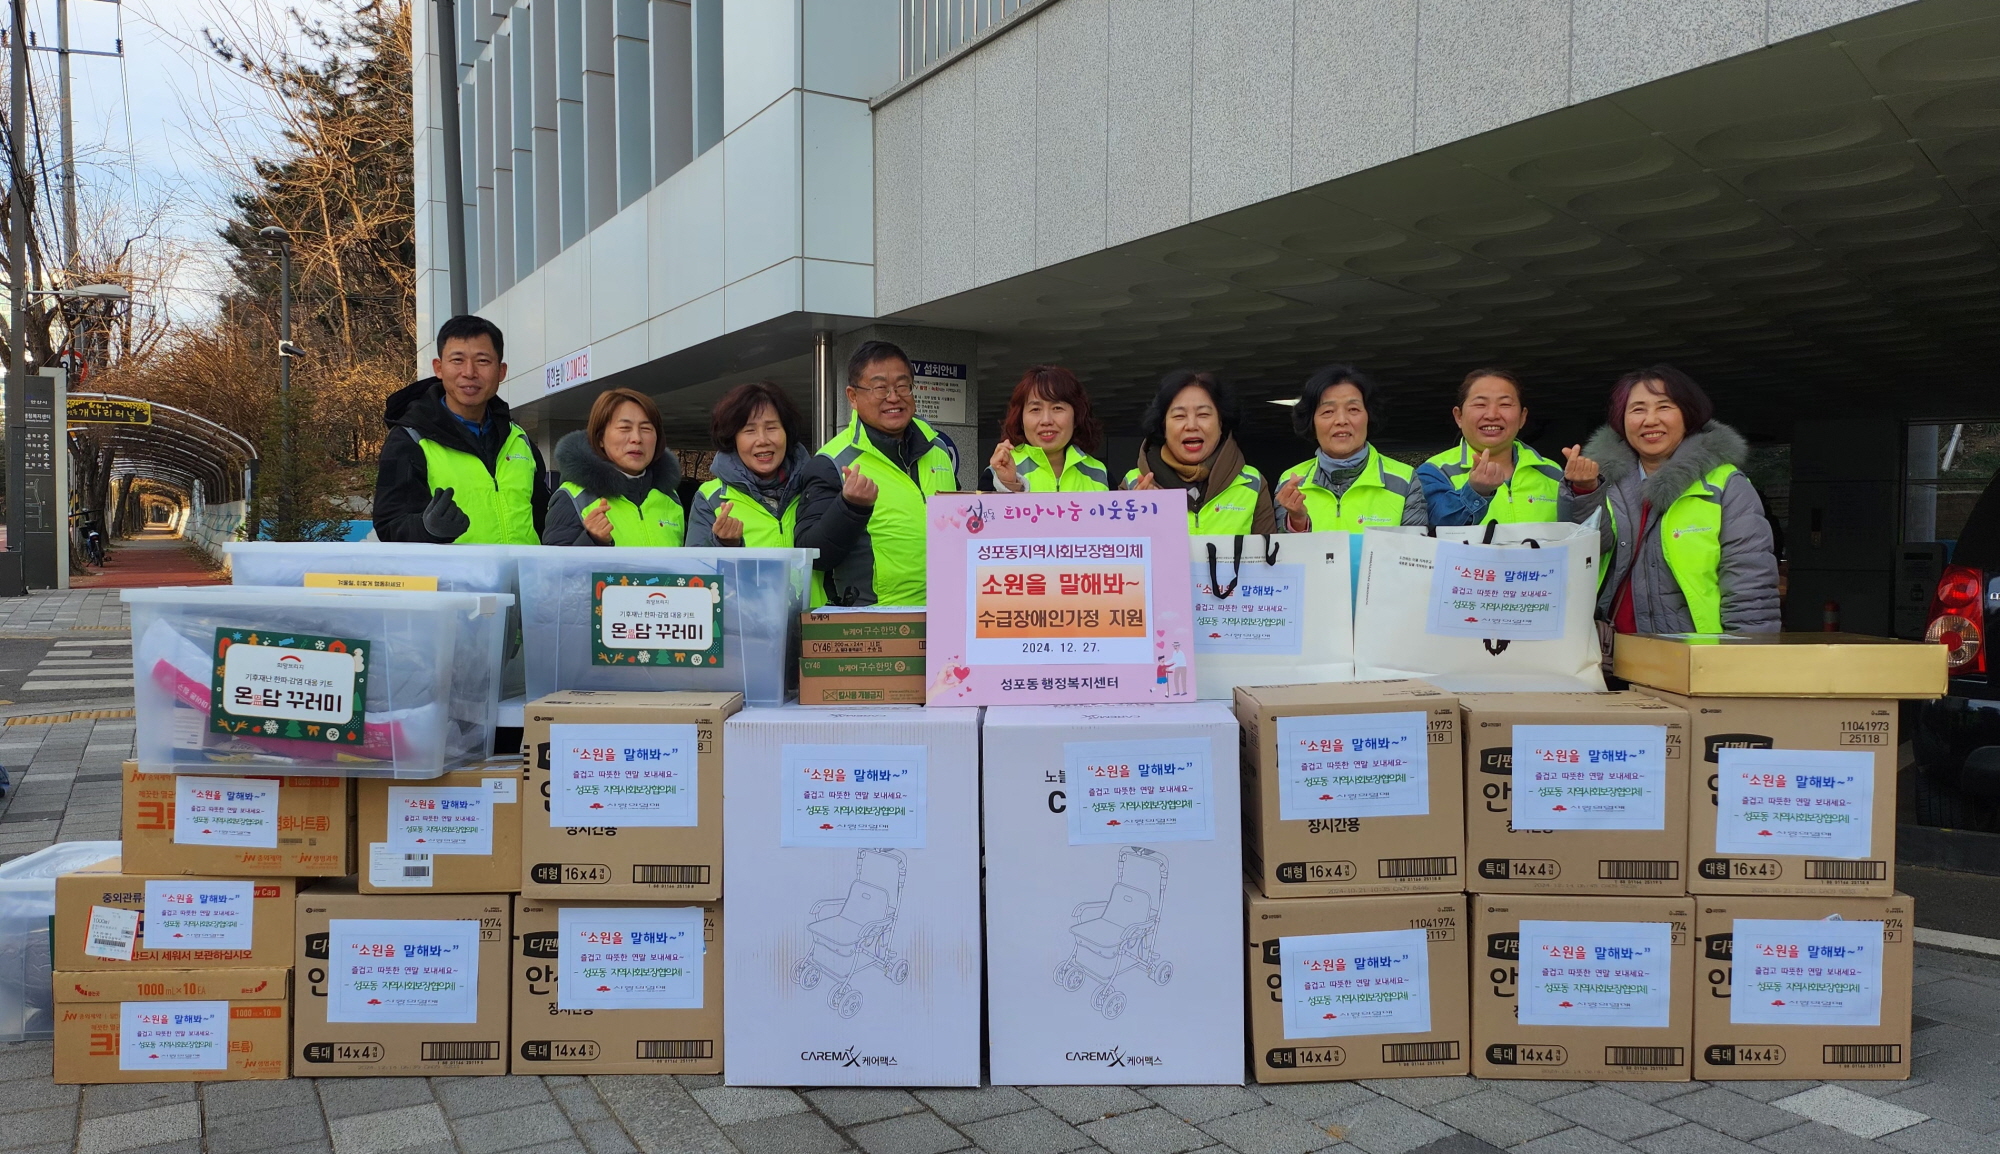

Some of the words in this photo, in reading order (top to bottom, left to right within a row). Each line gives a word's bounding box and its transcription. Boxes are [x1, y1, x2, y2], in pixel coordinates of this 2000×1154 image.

[923, 363, 958, 377] 설치안내
[1003, 500, 1083, 524] 희망나눔
[1089, 499, 1158, 521] 이웃돕기
[977, 544, 1143, 560] 성포동지역사회보장협의체
[1454, 565, 1497, 582] “소원을
[1504, 568, 1555, 583] 말해봐~”
[981, 573, 1047, 596] 소원을
[1059, 572, 1140, 596] 말해봐~
[1241, 585, 1289, 597] 말해봐~”
[619, 610, 643, 618] 기후재난
[670, 611, 682, 619] 대응
[682, 611, 695, 619] 키트
[978, 609, 1099, 628] 수급장애인가정
[1109, 608, 1143, 628] 지원
[655, 623, 703, 640] 꾸러미
[842, 628, 863, 636] 뉴케어
[863, 625, 897, 636] 구수한맛
[812, 642, 831, 653] CY46
[1022, 642, 1054, 653] 2024.
[1060, 642, 1077, 653] 12.
[1083, 642, 1101, 653] 27.
[804, 661, 821, 669] CY46
[838, 663, 858, 672] 뉴케어
[859, 662, 893, 672] 구수한맛
[245, 673, 273, 683] 기후재난
[304, 678, 318, 687] 대응
[319, 679, 333, 688] 키트
[1001, 677, 1039, 691] 성포동
[1041, 676, 1119, 690] 행정복지센터
[286, 690, 342, 713] 꾸러미
[1840, 721, 1890, 732] 11041973
[1300, 738, 1344, 754] “소원을
[1351, 735, 1408, 751] 말해봐~”
[1849, 734, 1881, 744] 25118
[572, 747, 616, 761] “소원을
[623, 747, 678, 761] 말해봐~”
[1535, 749, 1581, 763] “소원을
[1588, 749, 1646, 764] 말해봐~”
[1087, 763, 1131, 779] “소원을
[1138, 761, 1193, 777] 말해봐~”
[1301, 761, 1323, 771] 즐겁고
[1326, 760, 1349, 770] 따뜻한
[1353, 759, 1369, 769] 연말
[1372, 758, 1408, 768] 보내세요~
[803, 767, 847, 782] “소원을
[853, 767, 908, 782] 말해봐~”
[1303, 775, 1328, 787] 성포동
[1332, 772, 1407, 786] 지역사회보장협의체
[1741, 772, 1787, 788] “소원을
[1794, 774, 1853, 790] 말해봐~”
[191, 789, 222, 800] “소원을
[226, 790, 265, 802] 말해봐~”
[803, 790, 824, 799] 즐겁고
[828, 790, 850, 799] 따뜻한
[854, 790, 869, 799] 연말
[873, 790, 908, 799] 보내세요~
[404, 799, 435, 809] “소원을
[440, 799, 480, 810] 말해봐~”
[805, 804, 829, 815] 성포동
[833, 804, 906, 816] 지역사회보장협의체
[1308, 818, 1360, 834] 장시간용
[538, 867, 558, 880] 대형
[1283, 866, 1303, 879] 대형
[1484, 862, 1506, 876] 특대
[1705, 863, 1726, 876] 대형
[161, 893, 193, 903] “소원을
[198, 893, 239, 904] 말해봐~”
[1409, 917, 1456, 929] 11041974
[580, 930, 623, 944] “소원을
[630, 930, 685, 944] 말해봐~”
[161, 950, 191, 961] 세워서
[193, 949, 252, 960] 보관하십시오
[351, 943, 396, 957] “소원을
[403, 943, 459, 958] 말해봐~”
[1541, 944, 1586, 959] “소원을
[1594, 945, 1651, 960] 말해봐~”
[1755, 943, 1800, 958] “소원을
[1807, 944, 1863, 959] 말해봐~”
[1302, 956, 1346, 973] “소원을
[1353, 953, 1409, 970] 말해봐~”
[136, 1014, 168, 1024] “소원을
[173, 1013, 214, 1024] 말해봐~”
[310, 1046, 331, 1059] 특대
[527, 1044, 548, 1057] 특대
[801, 1044, 862, 1068] CAREMAX
[861, 1056, 898, 1067] 케어맥스
[1065, 1045, 1126, 1068] CAREMAX
[1126, 1056, 1163, 1066] 케어맥스
[1492, 1047, 1513, 1061] 특대
[1711, 1049, 1732, 1061] 특대
[1272, 1052, 1293, 1064] 특대
